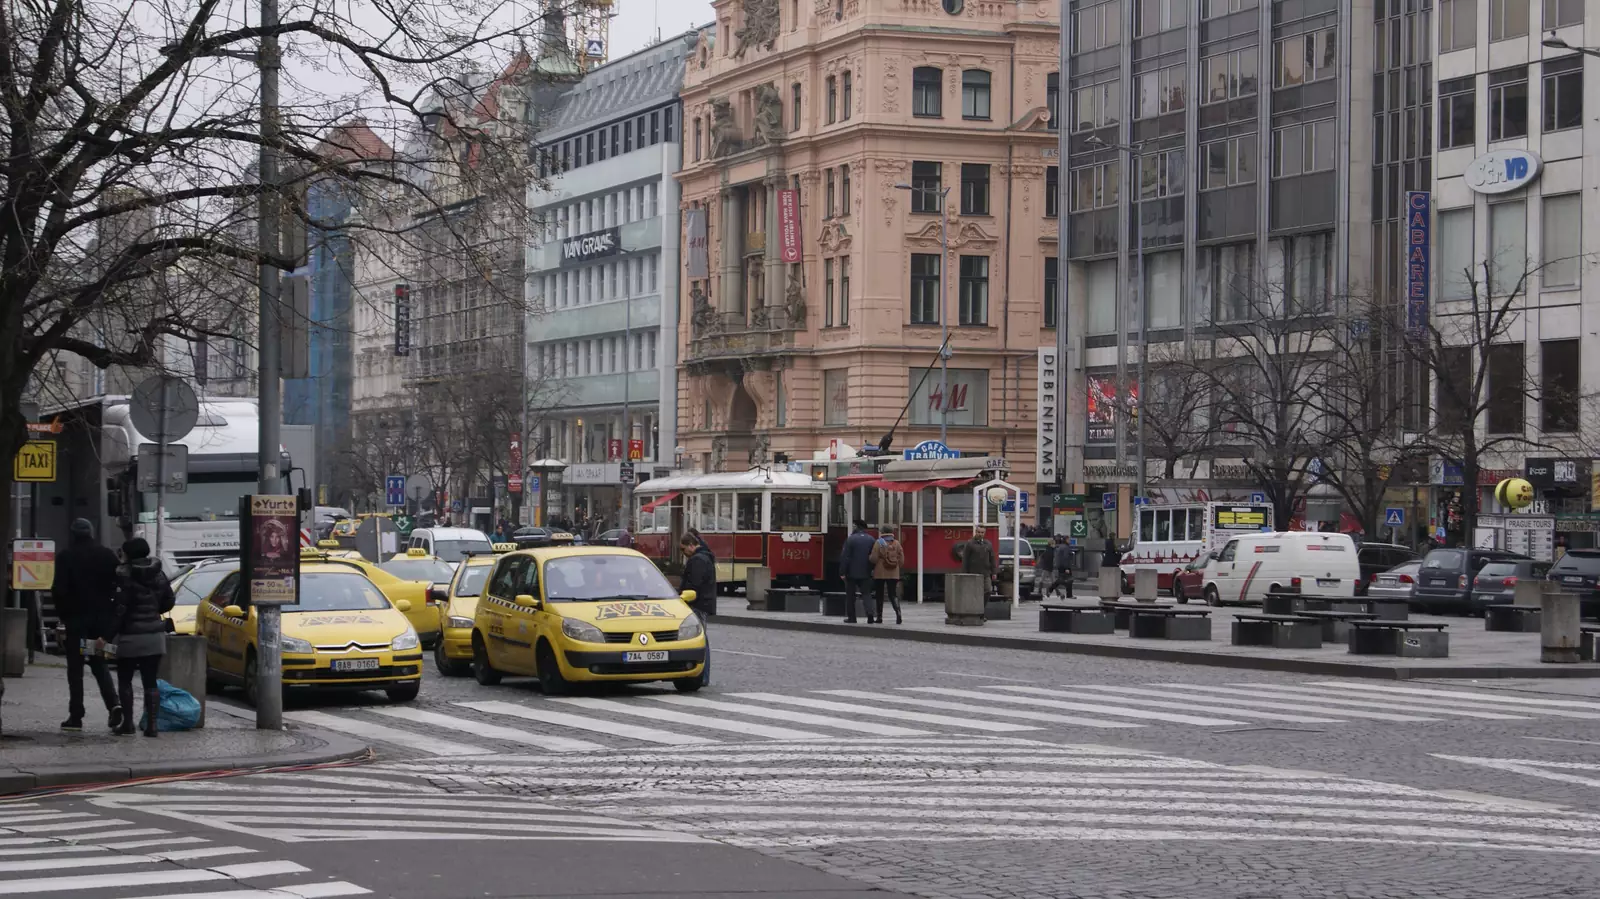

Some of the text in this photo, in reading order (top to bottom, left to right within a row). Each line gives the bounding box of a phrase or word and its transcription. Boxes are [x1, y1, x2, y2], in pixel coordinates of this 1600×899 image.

[563, 240, 581, 259] VAN
[1042, 354, 1055, 477] DEBENHAMS
[921, 443, 944, 453] CAFE
[23, 452, 49, 469] TAXI
[986, 459, 1006, 468] CAFE
[261, 499, 288, 509] Yurt
[1508, 520, 1532, 528] PRAGUE
[1533, 520, 1552, 528] TOURS
[495, 543, 516, 551] TAXI
[782, 548, 810, 560] 1429
[595, 601, 677, 620] AAA
[628, 652, 665, 660] 7A4 0587
